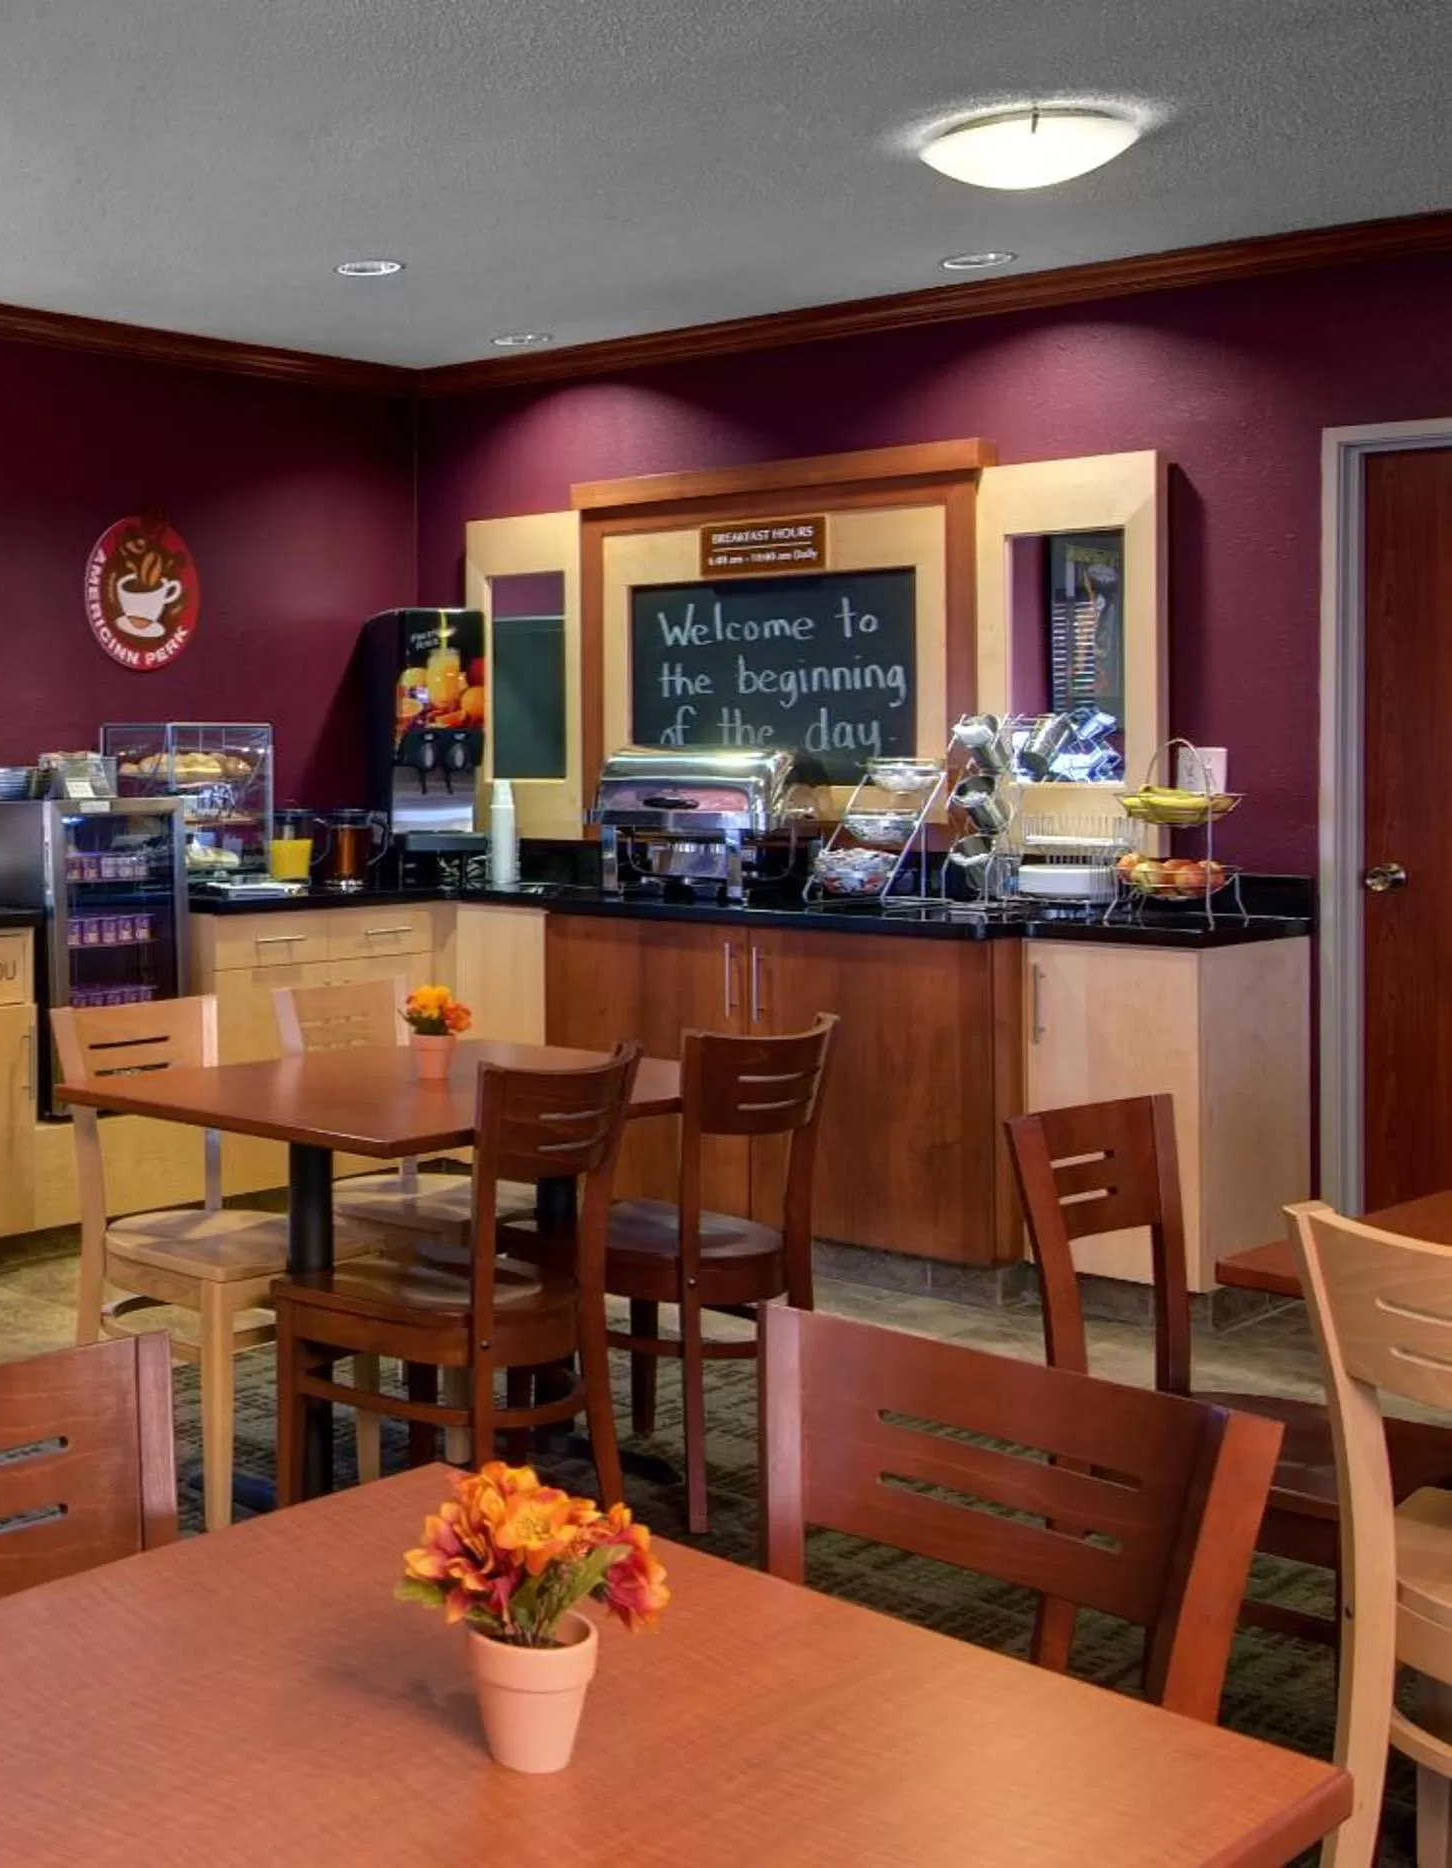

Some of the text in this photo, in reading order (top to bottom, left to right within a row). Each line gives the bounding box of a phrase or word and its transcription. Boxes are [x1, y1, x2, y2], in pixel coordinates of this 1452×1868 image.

[771, 525, 814, 541] HOURS
[88, 547, 189, 667] AMERICINN PERK
[657, 596, 879, 647] Welcome to
[659, 653, 907, 709] the beginning
[659, 704, 697, 746] of
[717, 706, 776, 746] the
